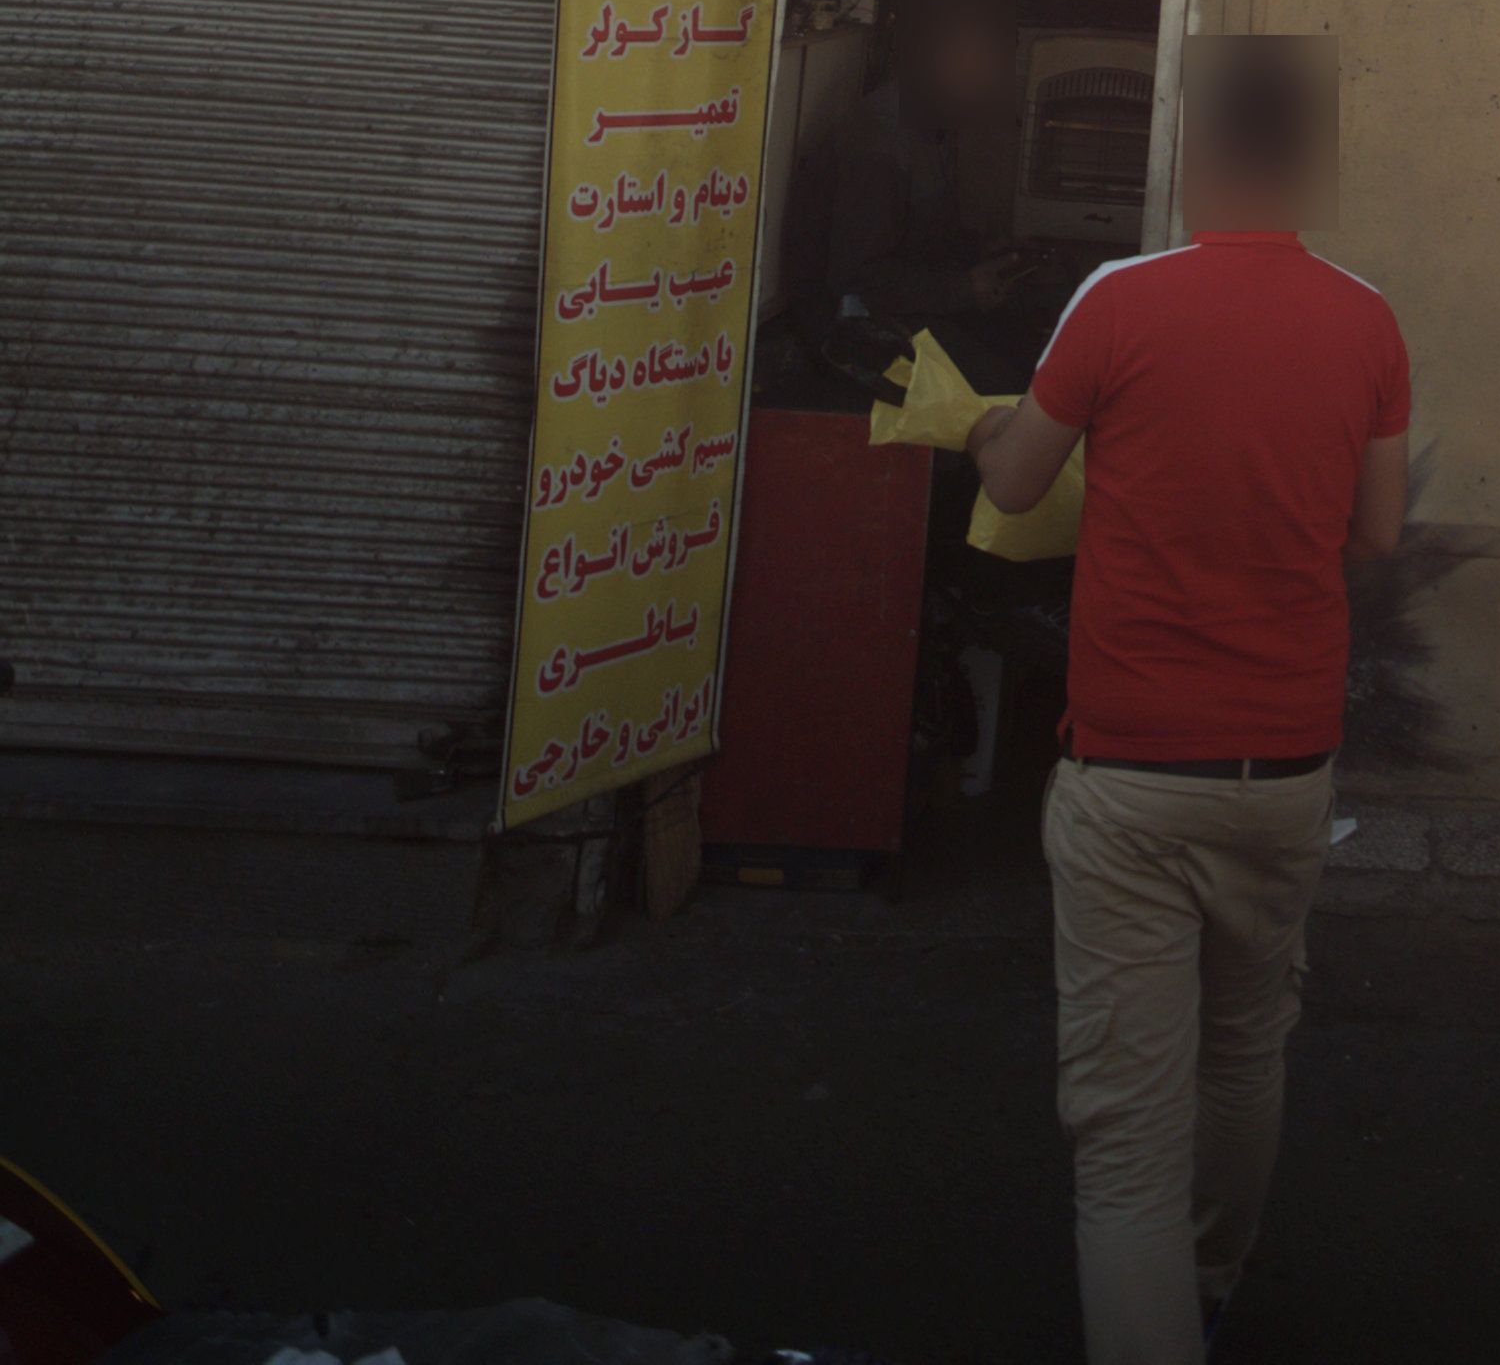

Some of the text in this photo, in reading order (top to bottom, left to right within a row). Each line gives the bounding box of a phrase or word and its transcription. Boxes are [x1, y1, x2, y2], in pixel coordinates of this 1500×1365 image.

[581, 4, 756, 58] گاز کولر
[588, 87, 741, 143] تعمیر
[569, 170, 749, 230] دینام و استارت
[557, 258, 735, 321] عیب یابی
[551, 334, 734, 404] با دستگاه دیاگ
[534, 426, 735, 508] سیم کشی خودرو
[535, 500, 722, 601] فروش انواع
[537, 601, 700, 694] باطری
[512, 677, 711, 799] ایرانی و خارجی
